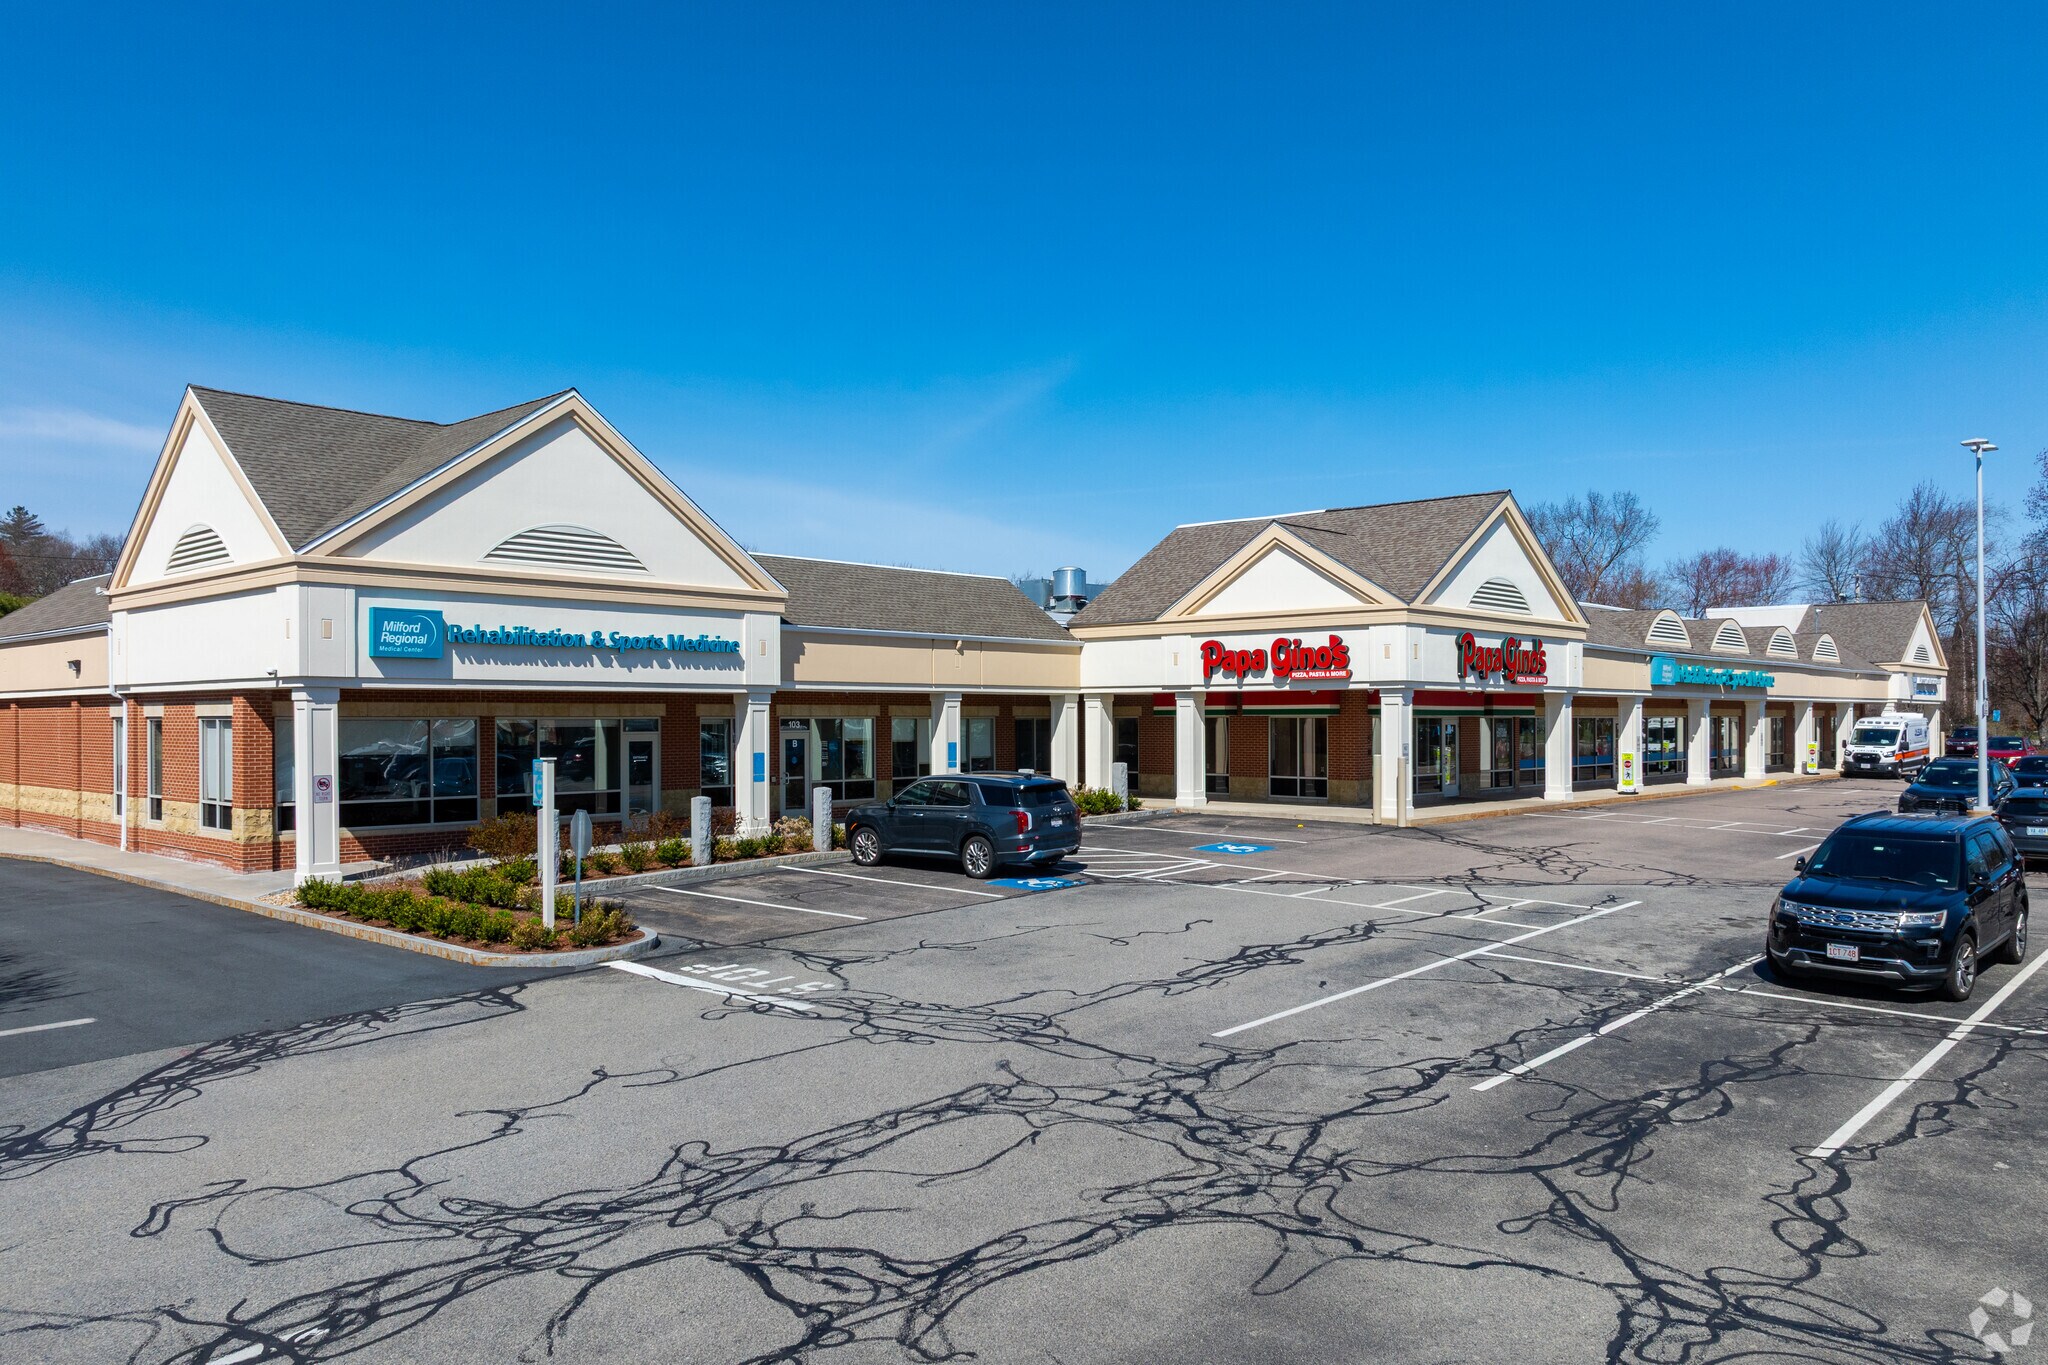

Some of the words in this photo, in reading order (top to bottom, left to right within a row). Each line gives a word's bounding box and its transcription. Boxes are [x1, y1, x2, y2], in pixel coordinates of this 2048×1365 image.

[382, 620, 421, 633] Milford
[380, 632, 428, 646] Regional
[447, 623, 586, 648] Rehabilitation
[590, 630, 605, 649] &
[608, 631, 664, 653] Sports
[667, 633, 740, 653] Medicine
[1200, 640, 1268, 679] Papa
[1270, 634, 1350, 678] Gino's
[1456, 632, 1503, 679] Papa
[1502, 636, 1547, 681] Gino's
[788, 720, 801, 729] 103
[792, 739, 798, 748] B
[680, 963, 836, 995] STOP
